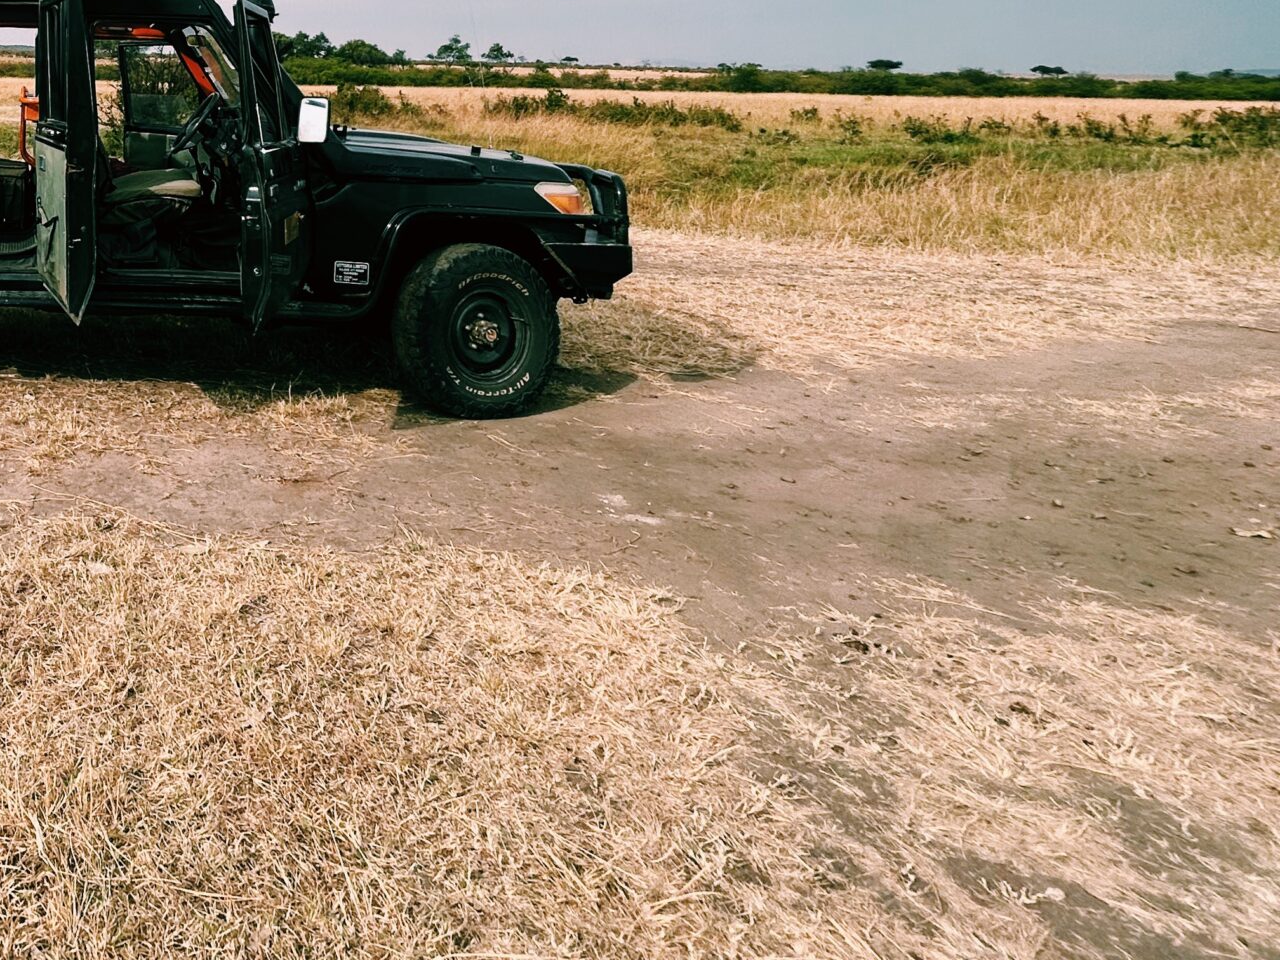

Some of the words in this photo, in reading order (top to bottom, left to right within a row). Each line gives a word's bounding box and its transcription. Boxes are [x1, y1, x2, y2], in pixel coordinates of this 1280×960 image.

[458, 273, 530, 296] BFGoodrich
[447, 366, 460, 385] T/A
[466, 371, 530, 396] All-Terrain
